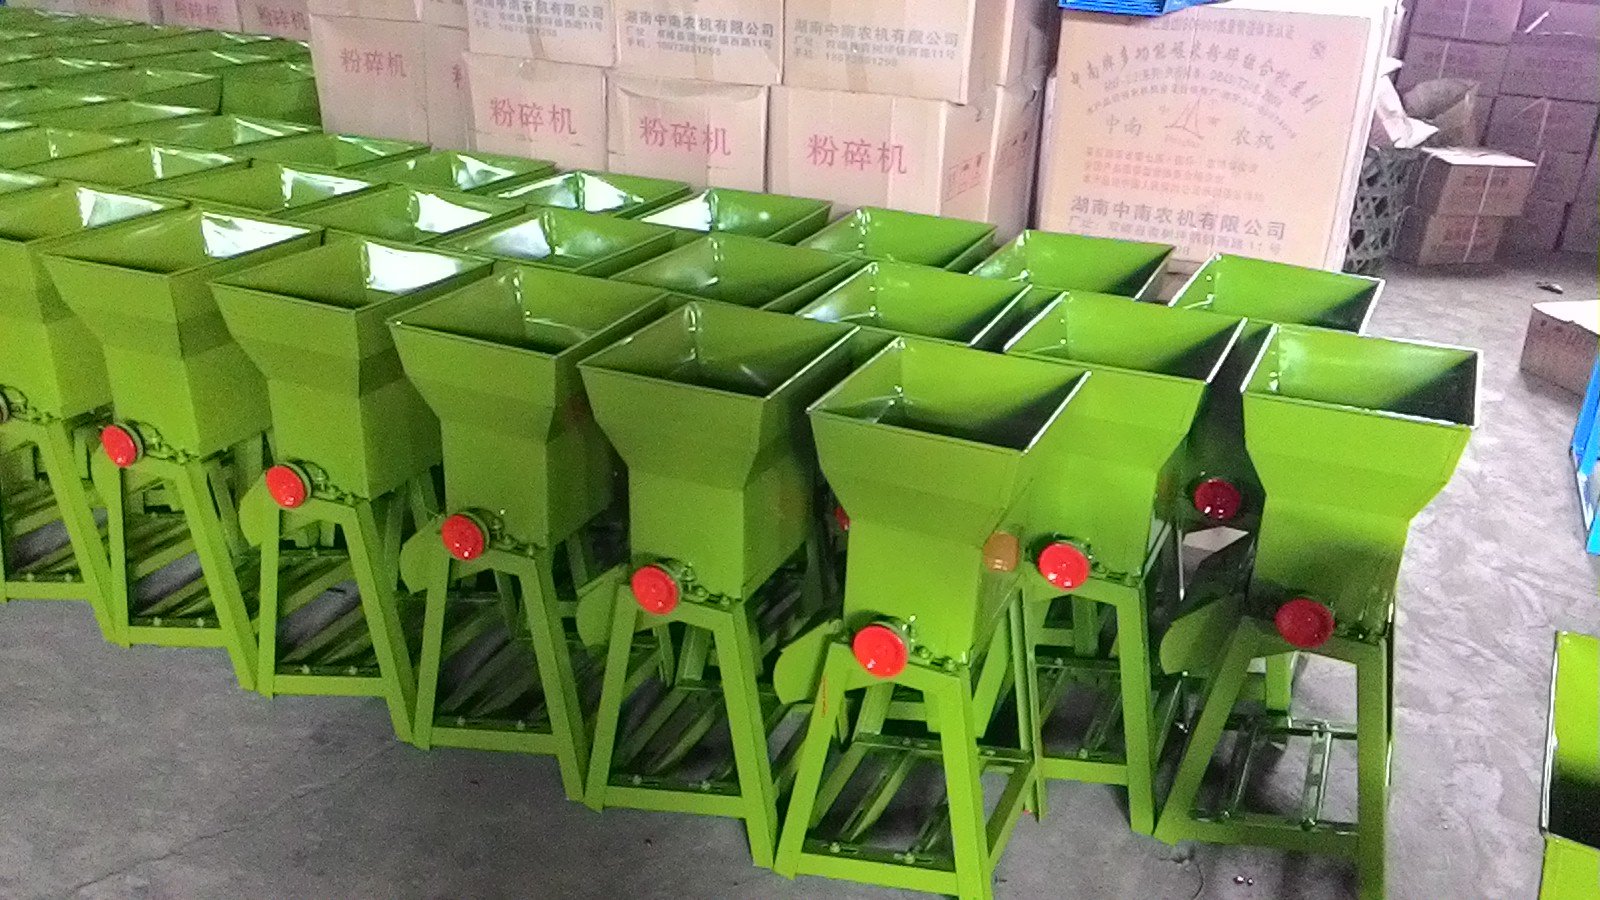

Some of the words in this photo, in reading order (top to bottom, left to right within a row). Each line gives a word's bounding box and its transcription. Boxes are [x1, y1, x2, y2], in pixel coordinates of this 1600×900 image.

[624, 10, 775, 38] 湖南中南农机有限公司
[793, 19, 960, 48] 湖南中南农机有限公司
[339, 46, 409, 80] 粉碎机
[488, 97, 578, 138] 粉碎机
[1105, 113, 1143, 138] 中南
[638, 115, 733, 158] 粉碎机
[1233, 125, 1277, 151] 农机
[807, 133, 908, 175] 粉碎机
[1069, 195, 1287, 241] 湖南中南农机有限公司
